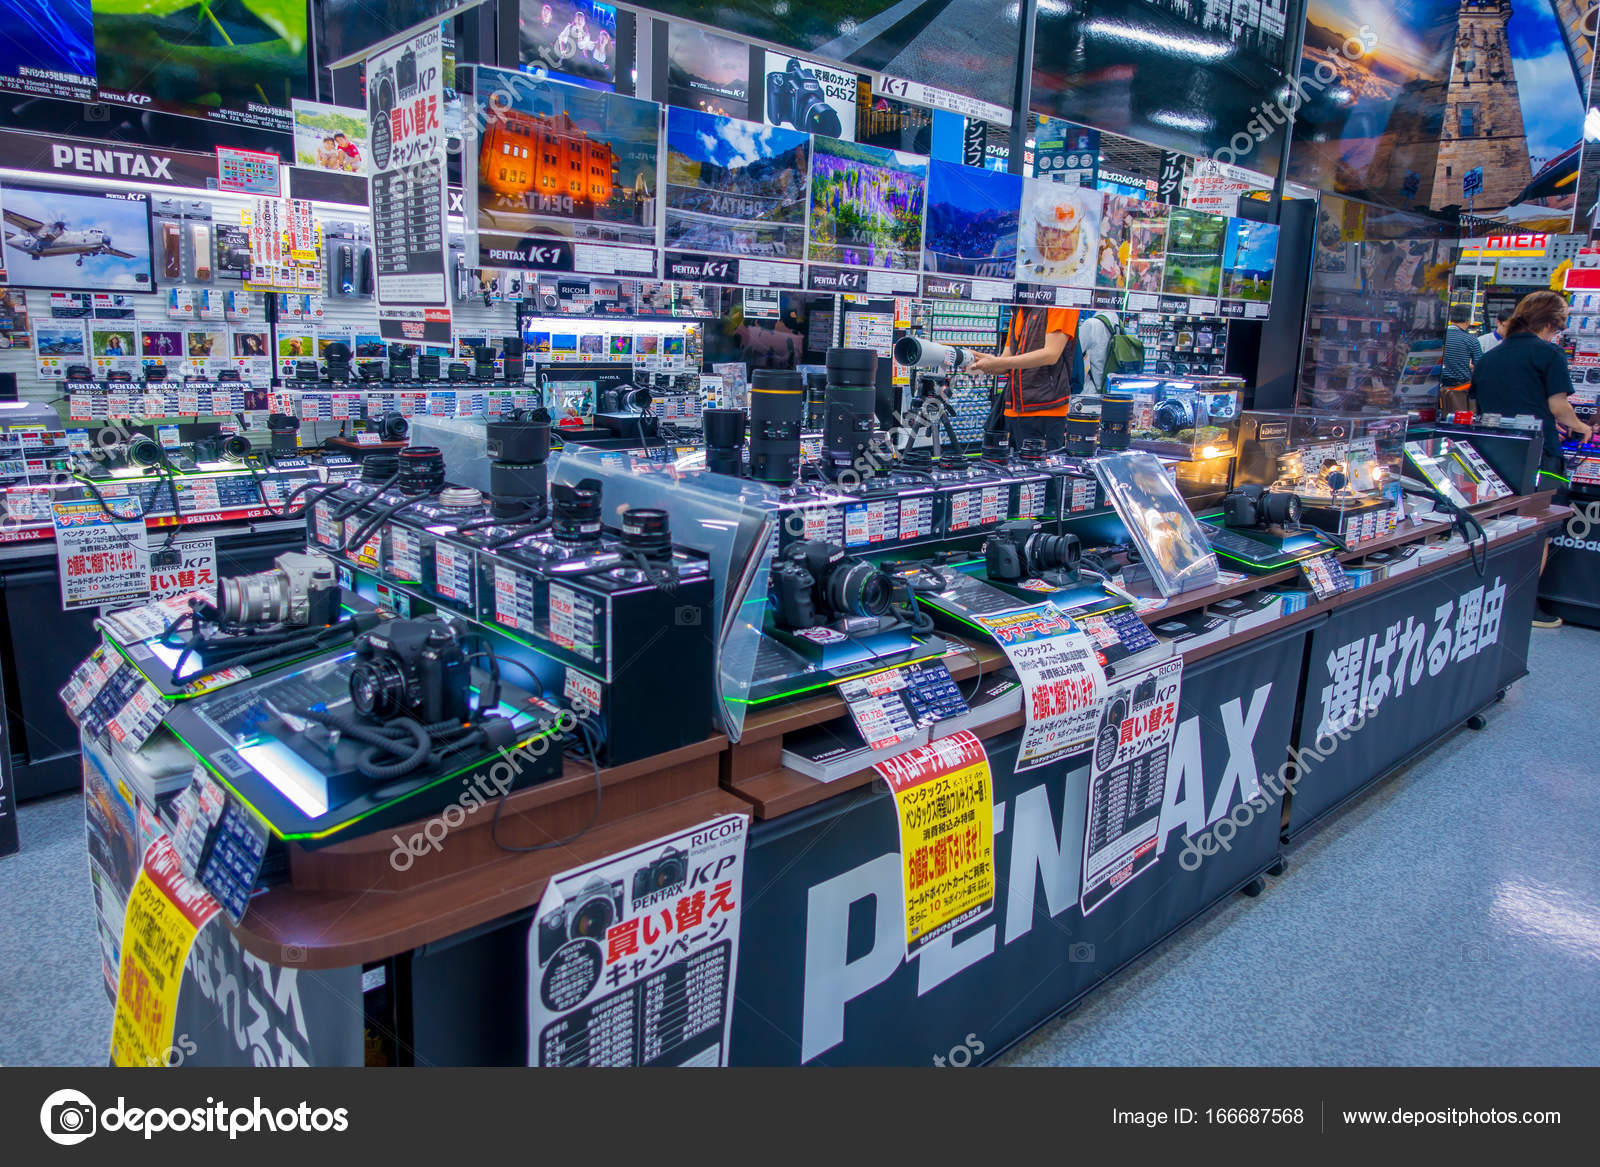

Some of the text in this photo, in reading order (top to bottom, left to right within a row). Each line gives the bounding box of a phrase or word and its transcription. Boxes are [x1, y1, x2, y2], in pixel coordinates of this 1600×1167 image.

[415, 30, 439, 51] RICOH
[418, 66, 436, 93] KP
[881, 77, 908, 97] K-1
[100, 92, 151, 104] PENTAX KP
[390, 94, 439, 144] 買い替え
[392, 136, 437, 166] キャンペーン
[52, 144, 173, 180] PENTAX
[127, 192, 146, 201] KP
[489, 249, 526, 261] PENTAX
[528, 246, 561, 264] K-1
[672, 261, 729, 277] PENTAX K-1
[814, 272, 859, 287] PENTAX K-1
[561, 286, 586, 295] RICOH
[594, 288, 617, 297] PENTAX
[948, 282, 966, 295] K-1
[1035, 290, 1052, 300] K-70
[563, 396, 584, 408] K-1
[1575, 405, 1598, 415] EOS
[278, 460, 306, 468] PENTAX
[326, 456, 352, 465] PENTAX
[187, 514, 223, 524] PENTAX
[62, 528, 108, 537] ペンタックス
[181, 540, 213, 550] RICOH
[183, 556, 212, 569] KP
[88, 584, 99, 592] 10
[1013, 642, 1056, 658] ペンタックス
[1316, 576, 1506, 743] 選ばれる理由
[1158, 663, 1182, 677] RICOH
[1154, 684, 1177, 705] KP
[1119, 701, 1175, 746] 買い替え
[1045, 731, 1056, 743] 10
[1117, 727, 1171, 762] キャンペーン
[903, 778, 951, 805] ペンタックス
[922, 809, 975, 841] 消費税込み特価
[691, 820, 743, 848] RICOH
[632, 854, 737, 913] PENTAX KP
[908, 862, 990, 912] ゴールドポイントカードご利用で
[909, 908, 928, 926] さらに
[930, 898, 941, 913] 10
[606, 879, 736, 966] 買い替え
[606, 918, 729, 988] キャンペーン
